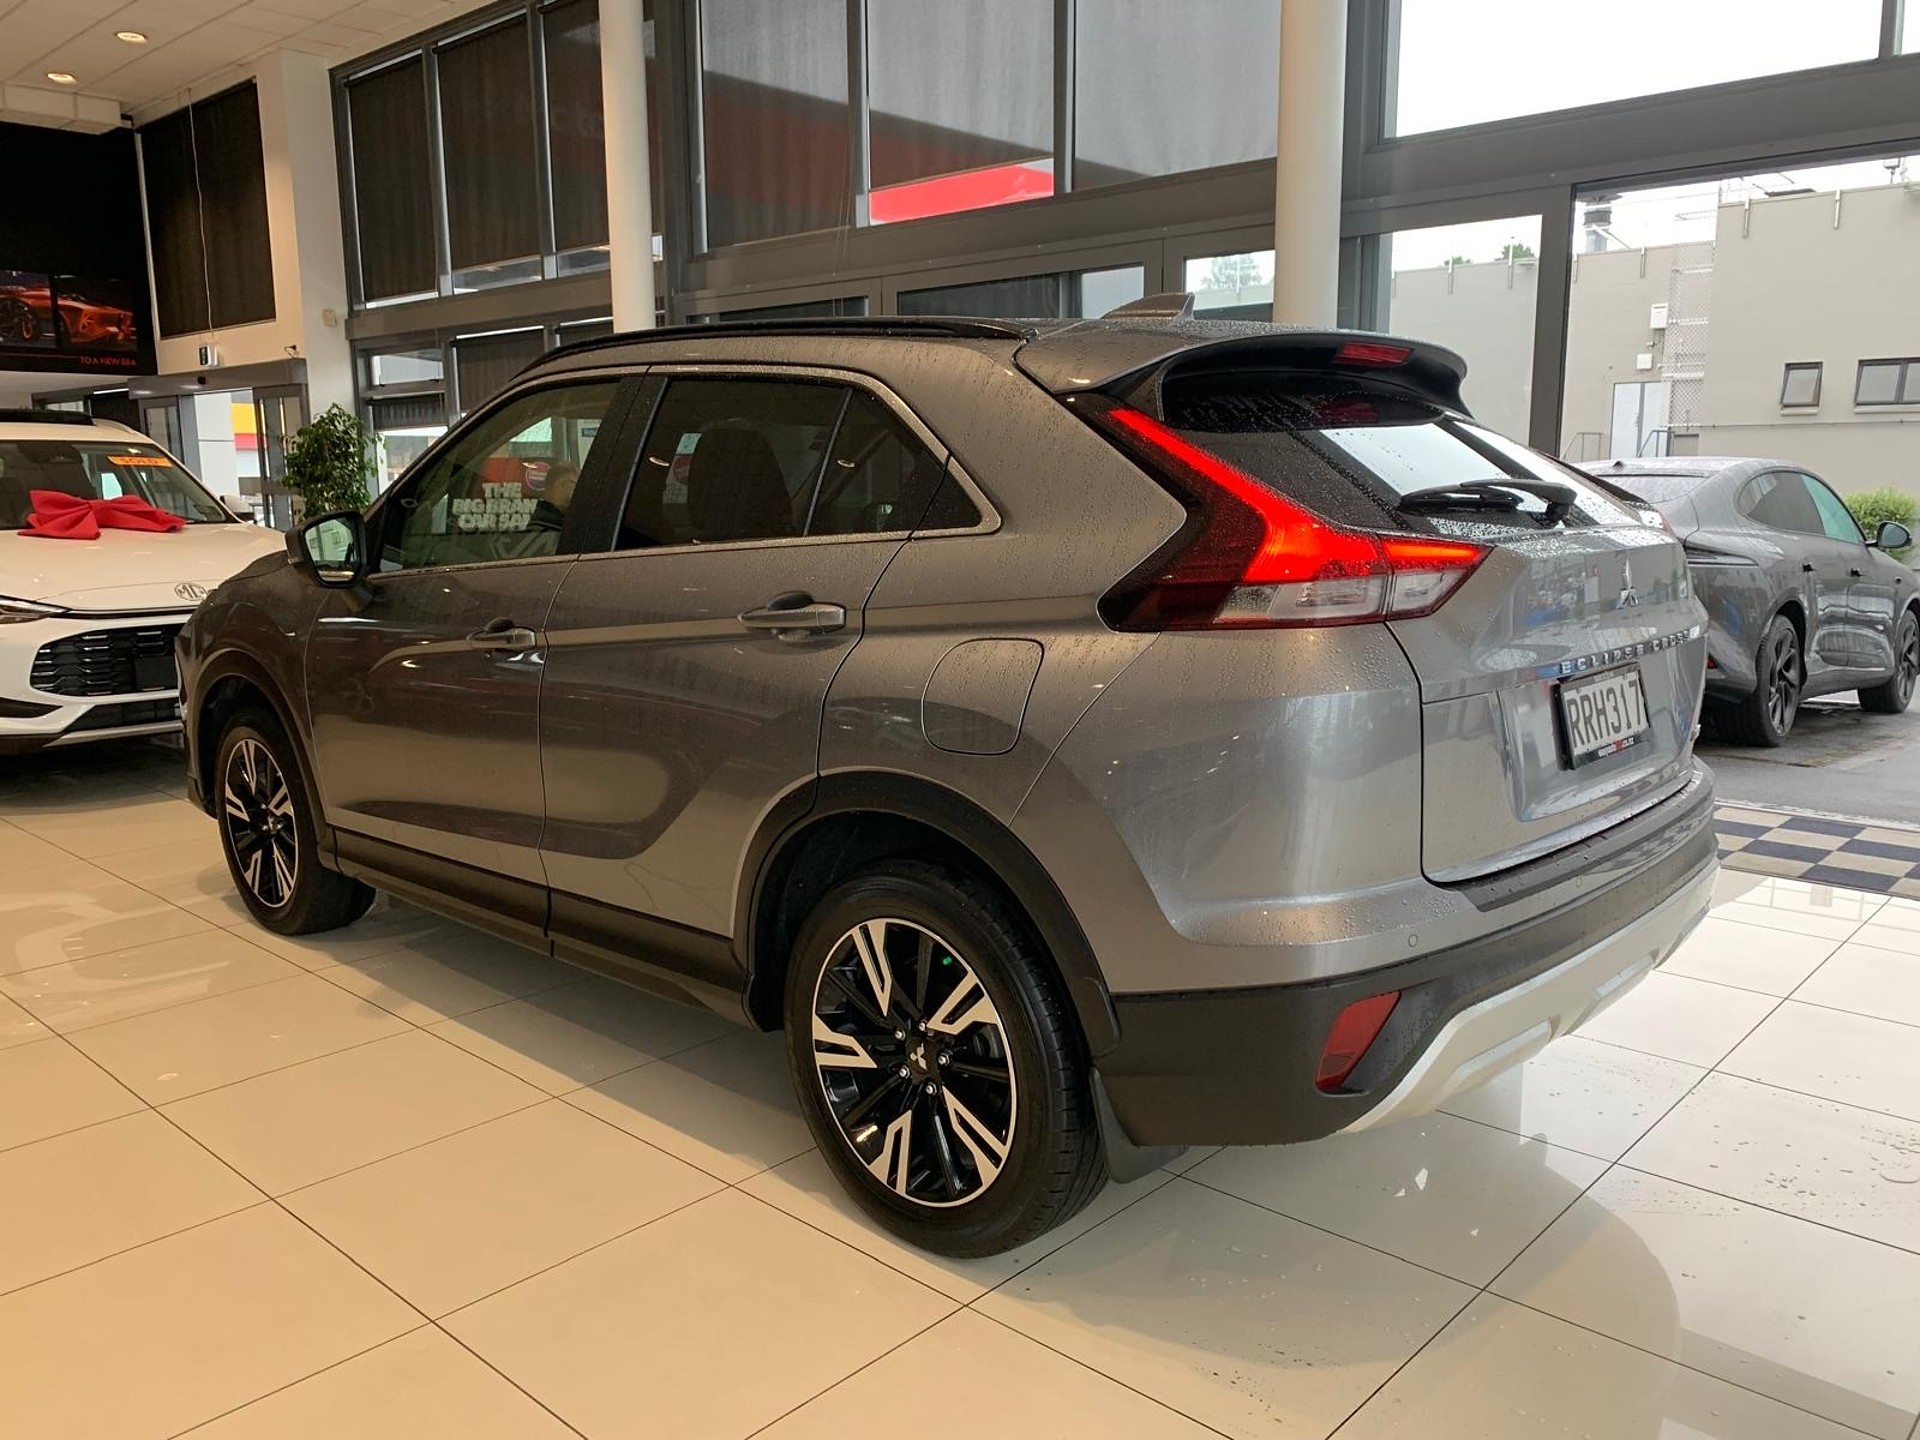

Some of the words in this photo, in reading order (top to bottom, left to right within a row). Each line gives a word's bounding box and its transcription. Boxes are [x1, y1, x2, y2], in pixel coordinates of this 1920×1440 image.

[100, 357, 119, 366] NEW
[121, 358, 137, 366] ERA
[482, 482, 522, 498] THE
[452, 498, 485, 515] BIG
[175, 583, 206, 600] MG
[1559, 643, 1644, 674] ECLIPSE
[1652, 630, 1689, 651] CROSS
[1566, 680, 1641, 748] RRH317
